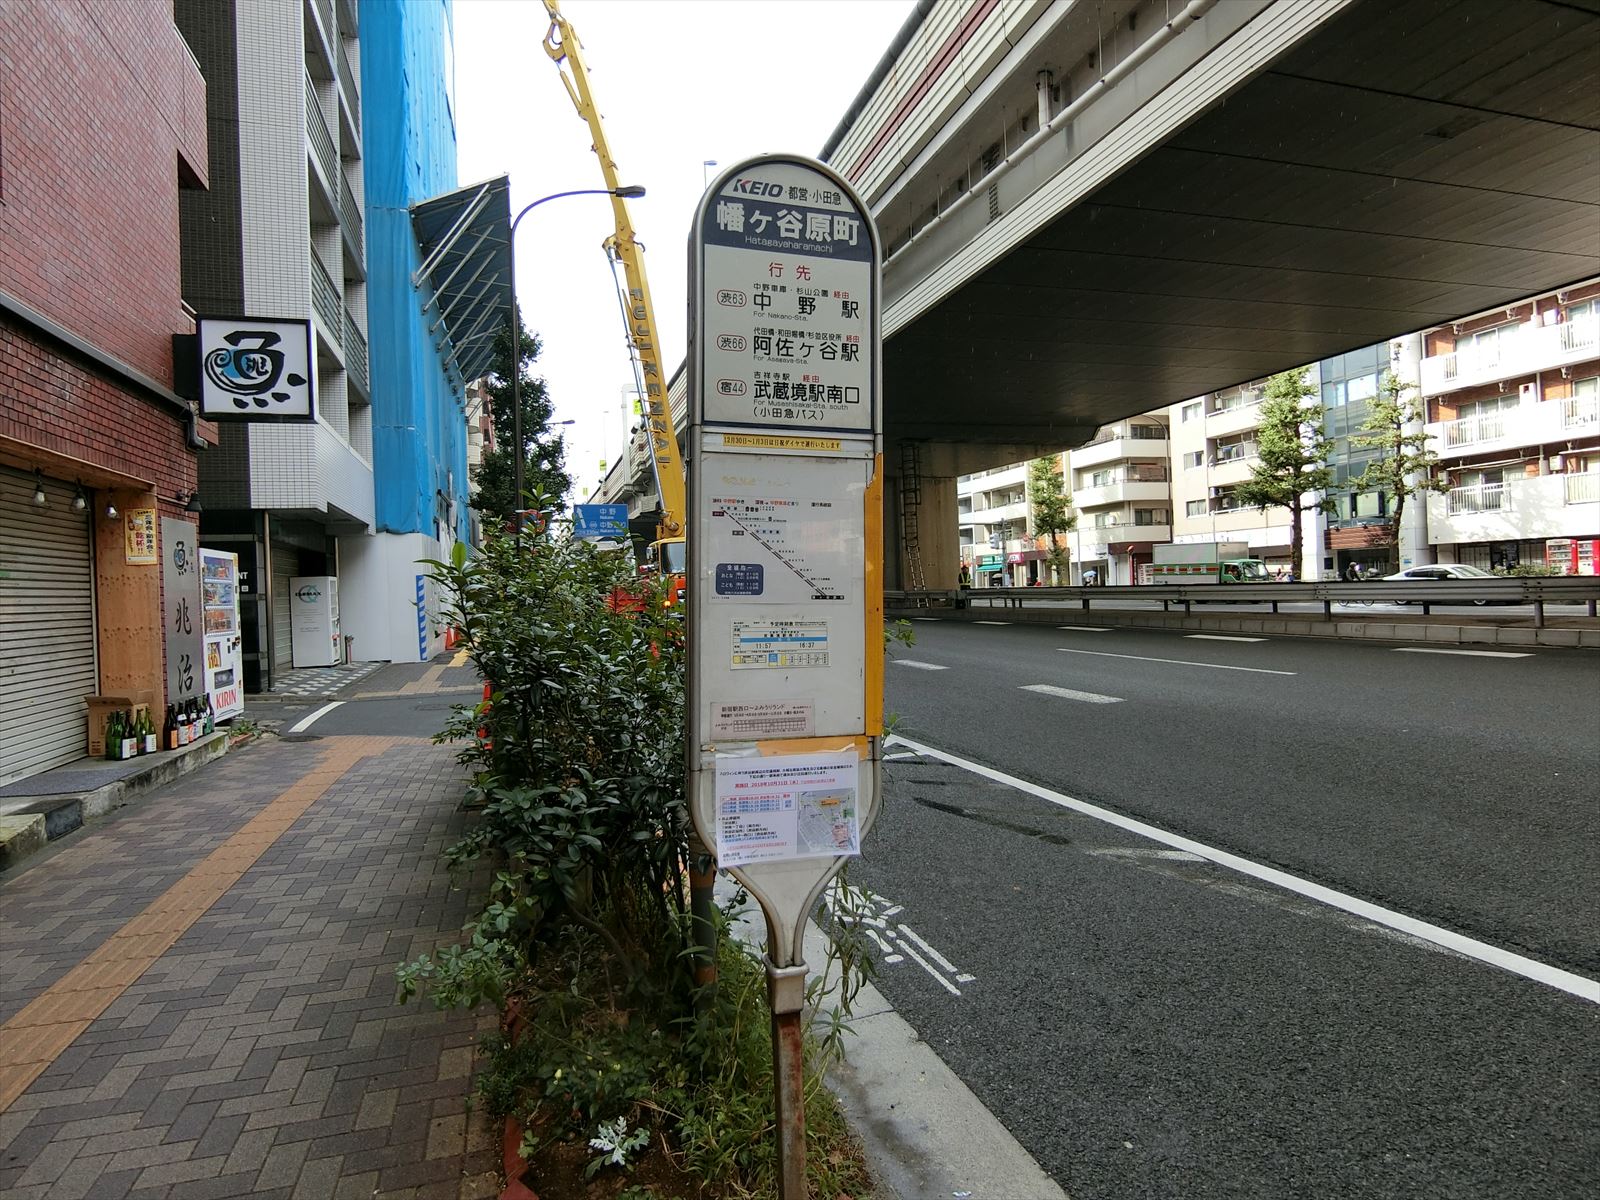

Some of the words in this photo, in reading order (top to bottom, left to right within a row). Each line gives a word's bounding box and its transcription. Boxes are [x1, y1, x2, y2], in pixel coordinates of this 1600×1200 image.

[733, 178, 783, 198] KEIO
[745, 235, 833, 254] Hatagayaharamachi
[720, 292, 744, 305] 渋63
[833, 290, 850, 299] 経由
[753, 292, 860, 320] 中野駅
[767, 312, 809, 321] Nakano-Sta.
[720, 336, 744, 350] 渋66
[846, 335, 860, 343] 経由
[630, 288, 652, 350] FUJI
[643, 363, 670, 463] KENZAI
[753, 371, 791, 381] 吉祥寺駅
[802, 374, 820, 383] 経由
[720, 381, 744, 394] 宿44
[753, 380, 860, 404] 武蔵境駅南口
[600, 508, 616, 516] 中野
[215, 689, 237, 709] KIRIN
